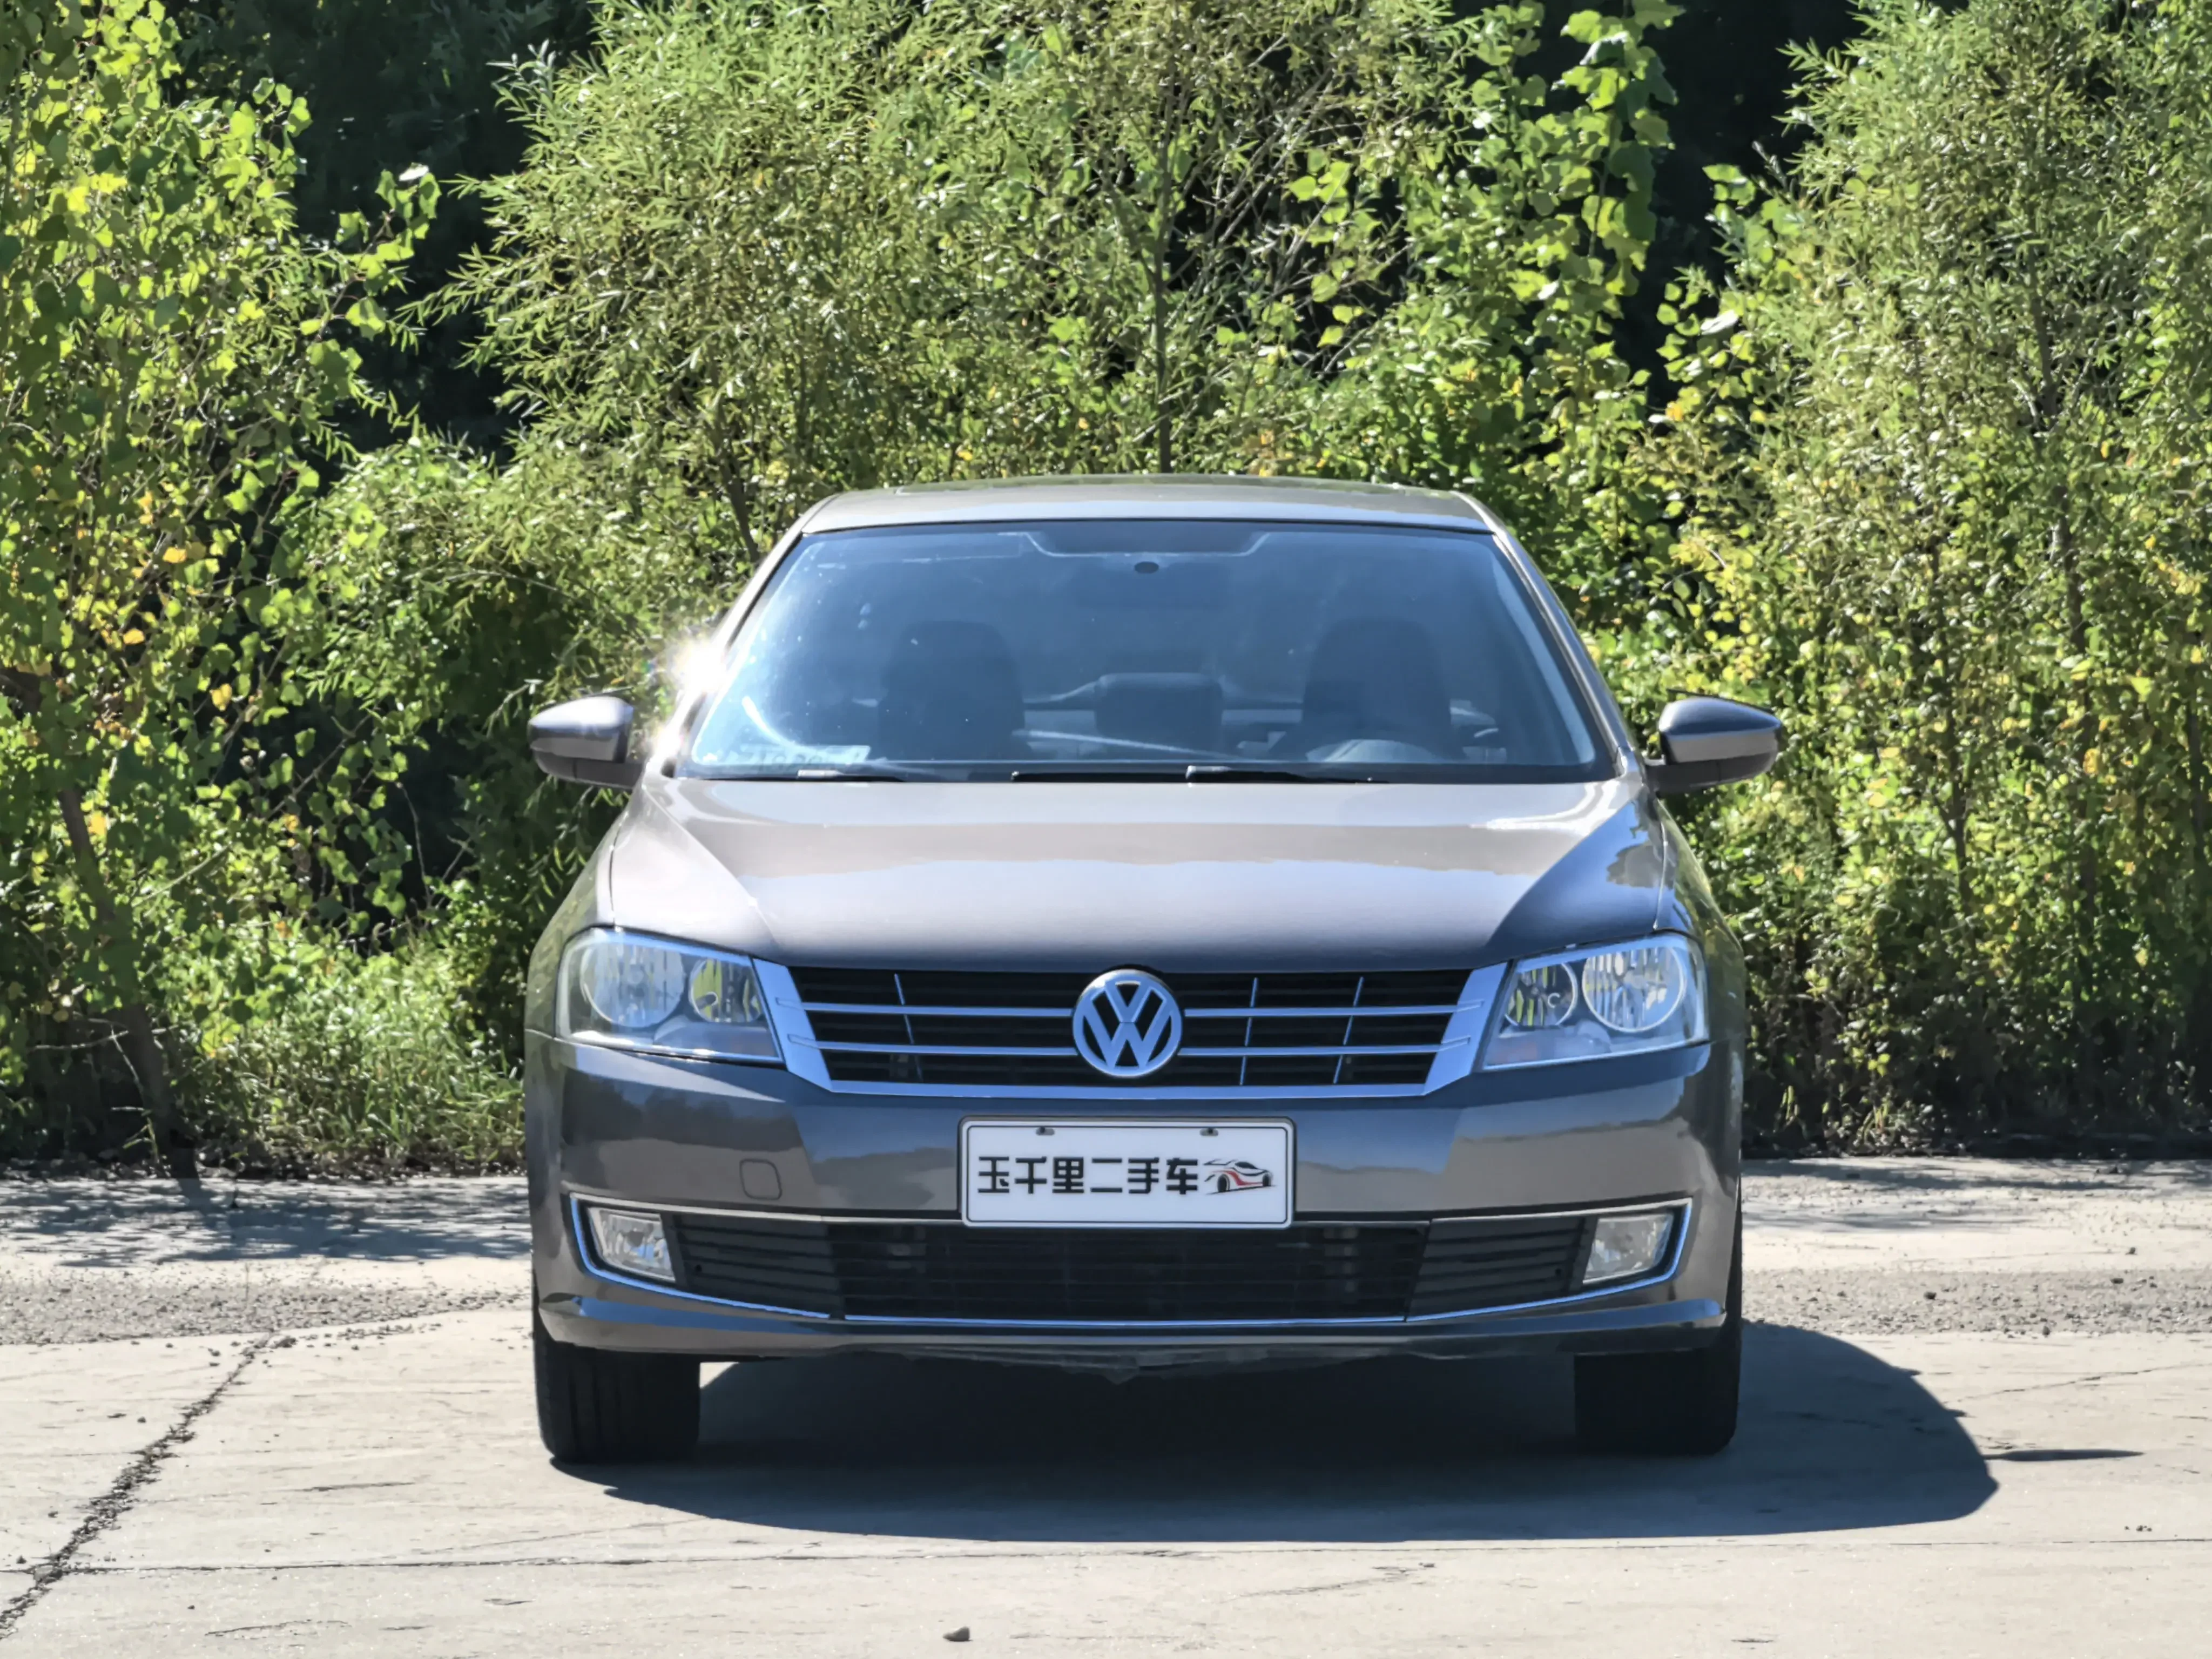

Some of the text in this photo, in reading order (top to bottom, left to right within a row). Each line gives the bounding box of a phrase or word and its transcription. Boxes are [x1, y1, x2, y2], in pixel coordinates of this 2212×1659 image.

[1078, 974, 1177, 1074] VW
[978, 1156, 1198, 1195] 玉千里二手车
